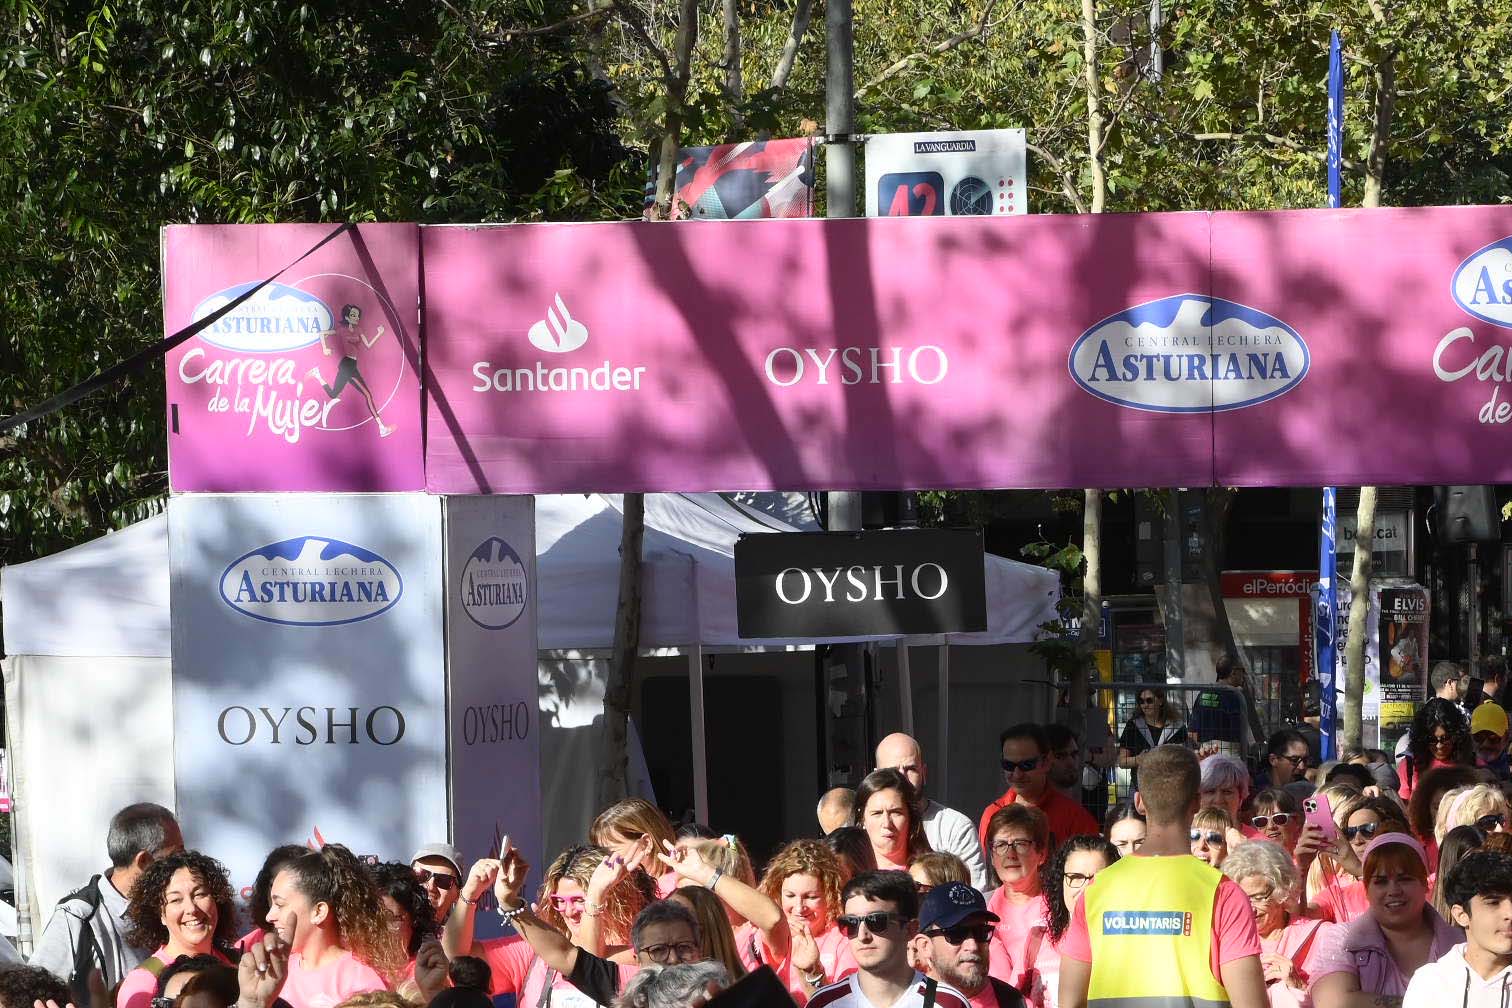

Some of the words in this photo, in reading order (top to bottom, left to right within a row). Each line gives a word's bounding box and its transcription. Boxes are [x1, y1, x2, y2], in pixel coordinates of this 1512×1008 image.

[1124, 335, 1202, 348] CENTRAL
[1208, 333, 1284, 347] LECHERA
[178, 347, 297, 386] Carrera
[472, 361, 647, 393] Santander
[764, 346, 949, 387] OYSHO
[1088, 339, 1292, 383] ASTURIANA
[207, 386, 229, 413] de
[234, 384, 251, 413] la
[247, 382, 342, 445] Mujer
[1478, 386, 1512, 425] de
[233, 569, 390, 605] ASTURIANA
[262, 566, 321, 577] CENTRAL
[325, 566, 384, 577] LECHERA
[466, 571, 524, 608] ASTURIANA
[775, 562, 949, 605] OYSHO
[1394, 598, 1425, 611] ELVIS
[217, 705, 406, 746] OYSHO
[463, 701, 529, 746] OYSHO
[1104, 917, 1181, 930] VOLUNTARIS
